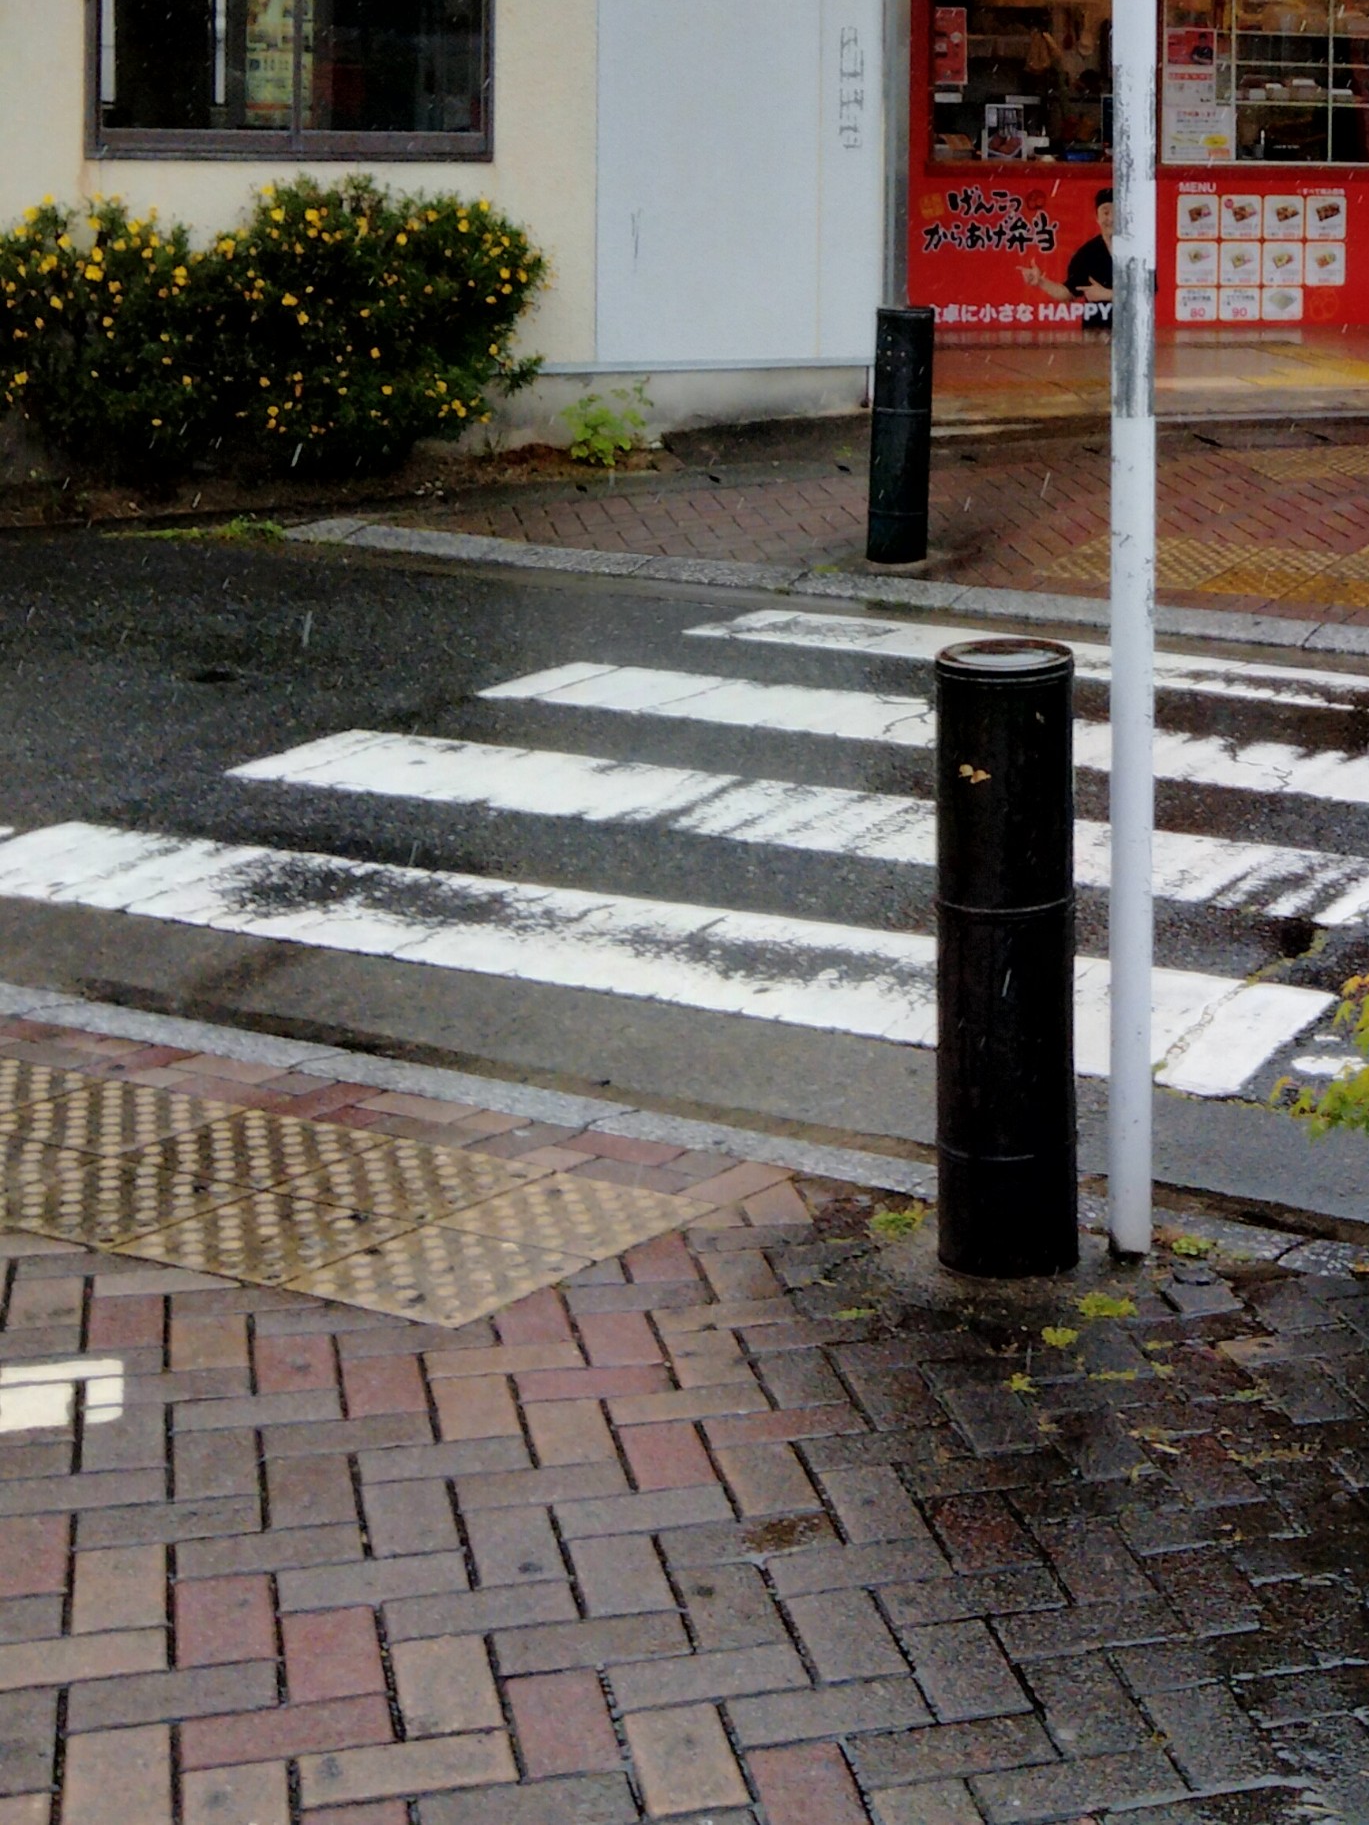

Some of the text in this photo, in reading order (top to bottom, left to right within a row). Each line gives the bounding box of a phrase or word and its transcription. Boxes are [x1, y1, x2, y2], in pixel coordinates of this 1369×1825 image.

[1178, 182, 1217, 193] MENU
[947, 185, 1022, 216] げんこつ
[923, 211, 1063, 253] からあげ弁当
[1038, 302, 1113, 321] HAPPY
